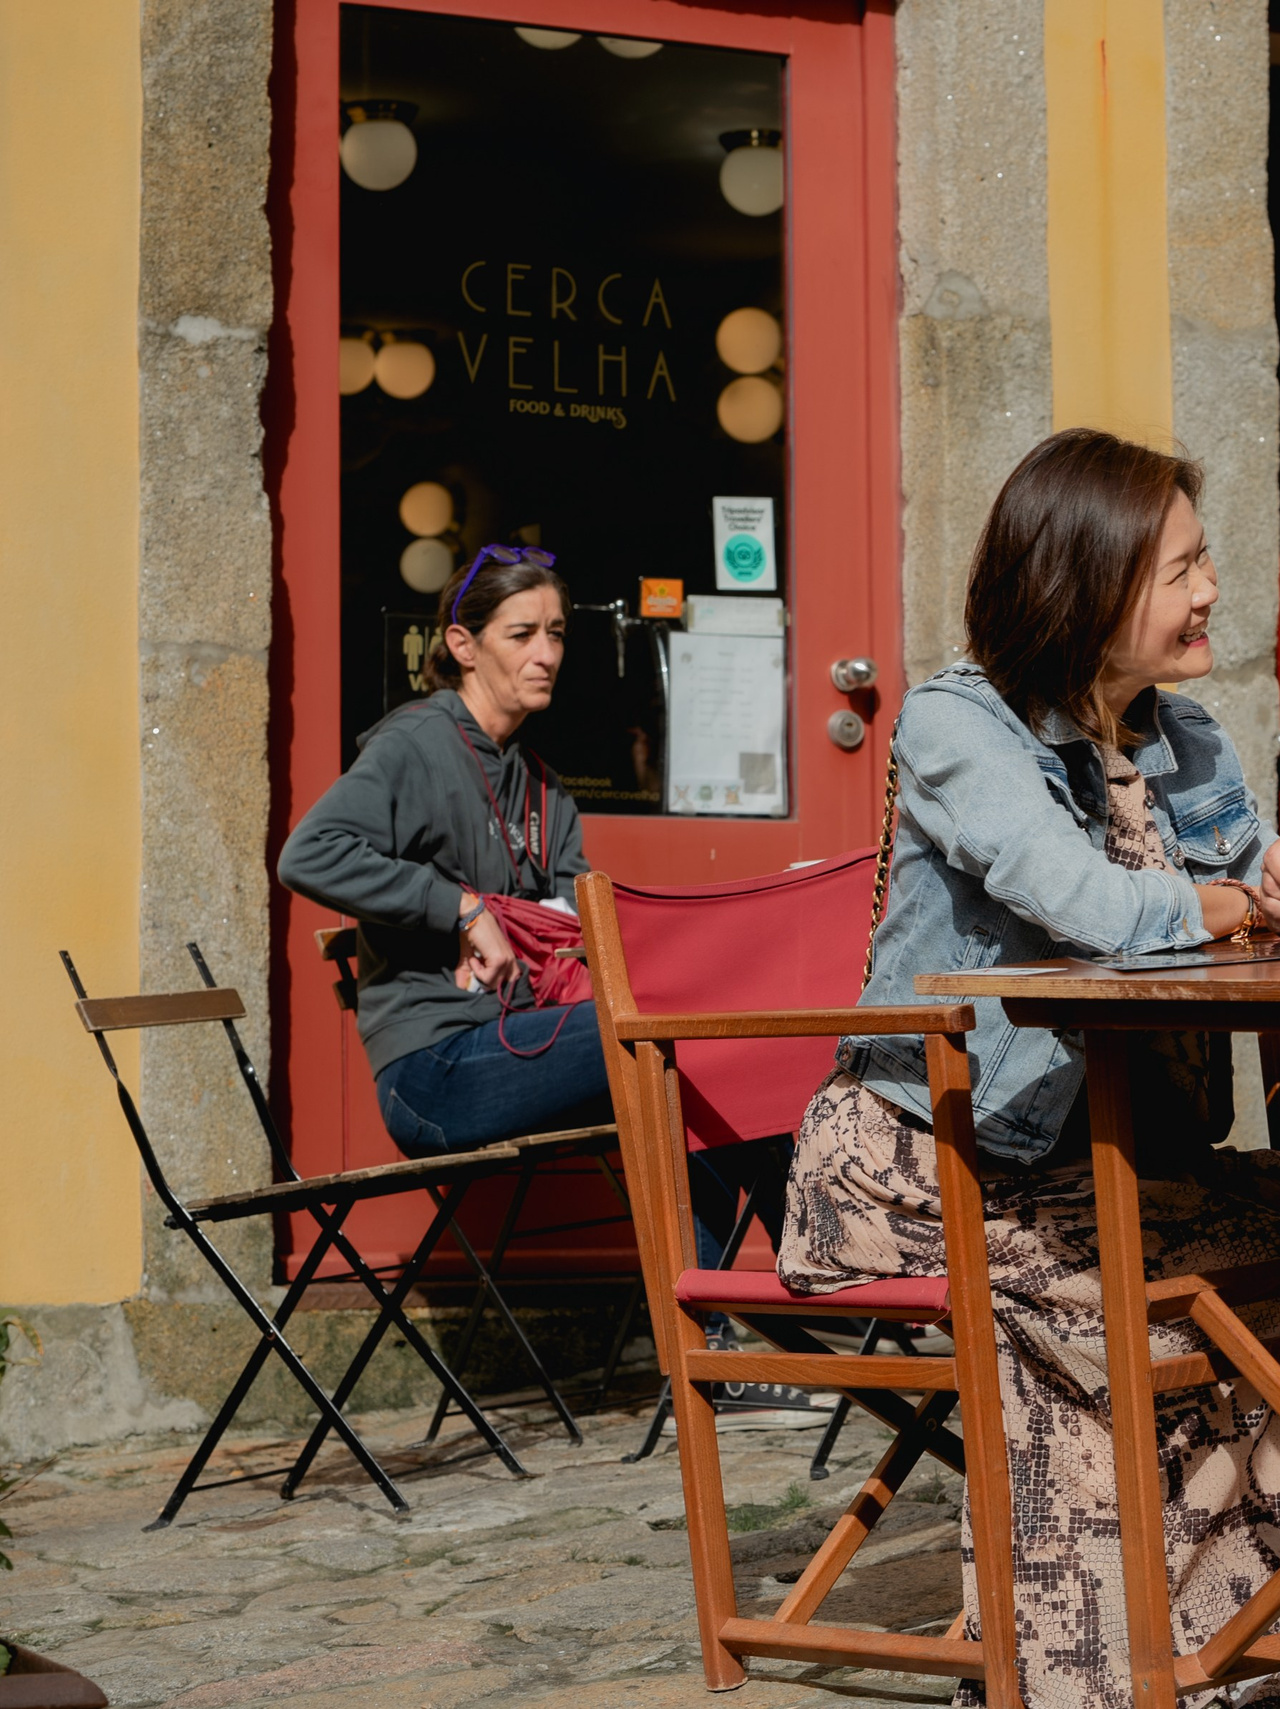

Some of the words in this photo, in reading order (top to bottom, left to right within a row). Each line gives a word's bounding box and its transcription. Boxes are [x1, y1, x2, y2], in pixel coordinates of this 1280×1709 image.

[461, 261, 672, 329] CERCA
[457, 331, 676, 402] VELHA
[509, 399, 550, 414] FOOD
[553, 402, 566, 417] &
[569, 403, 627, 429] DRINKS
[408, 674, 429, 692] W
